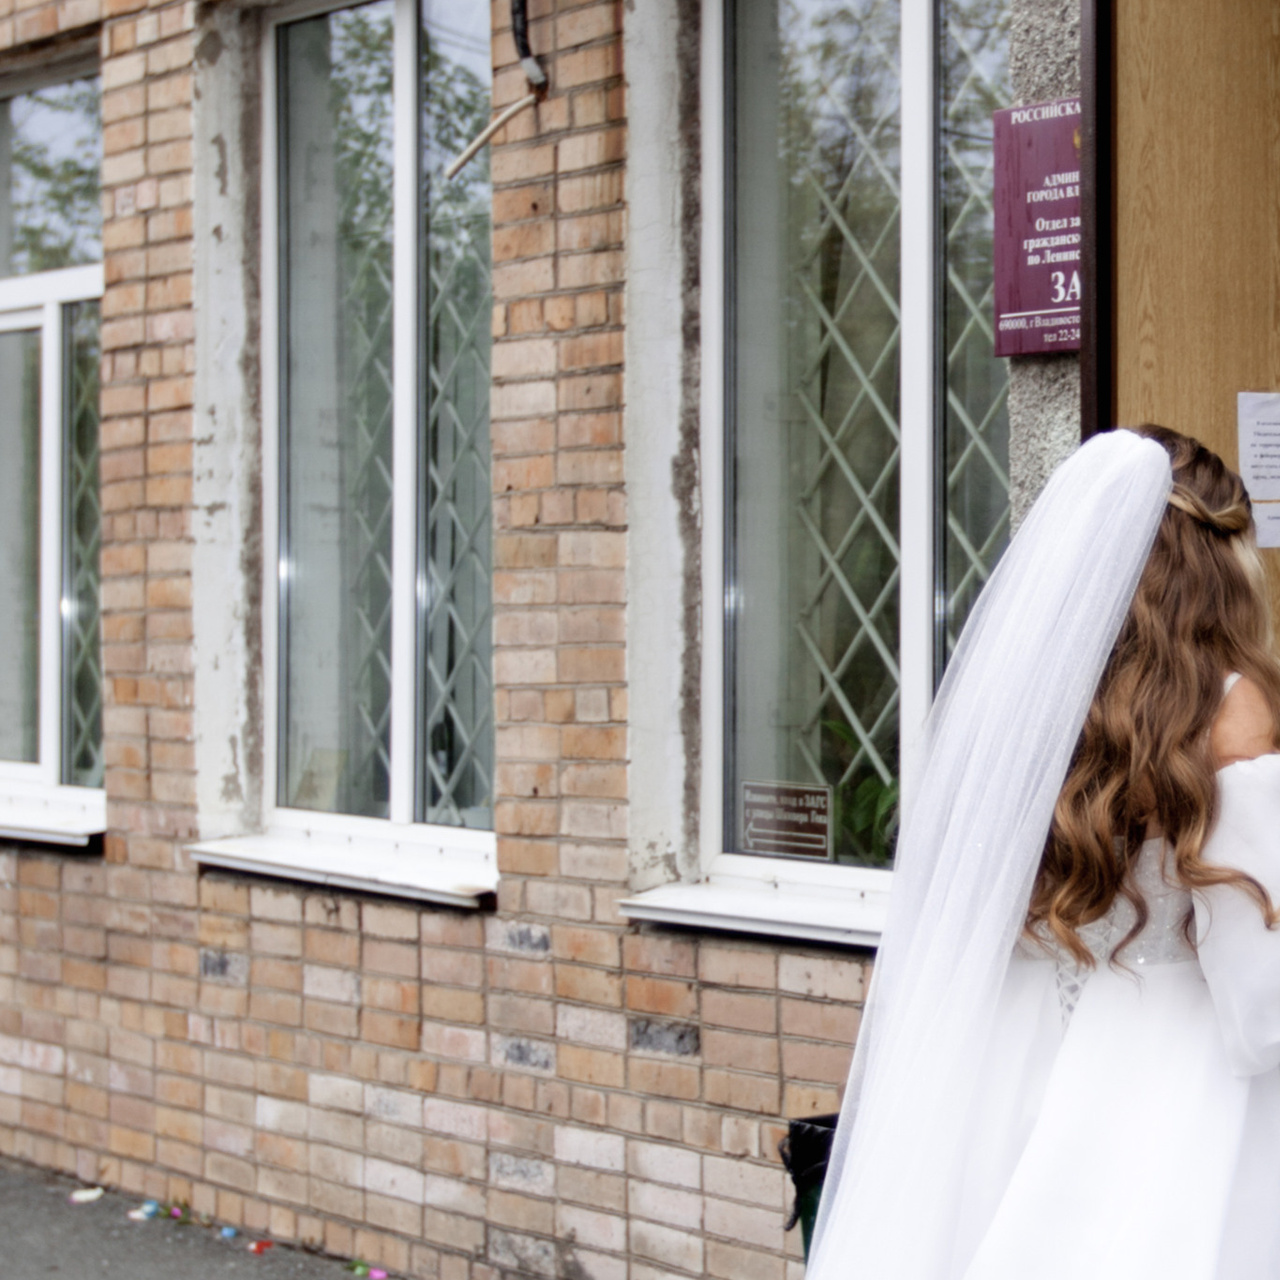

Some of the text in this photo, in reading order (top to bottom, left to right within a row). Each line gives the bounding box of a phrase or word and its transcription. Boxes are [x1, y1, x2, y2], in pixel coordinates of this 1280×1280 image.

[1027, 188, 1064, 203] ГОРОДА
[1035, 217, 1067, 232] Отдел
[1027, 255, 1040, 265] по
[1051, 270, 1081, 303] ЗА
